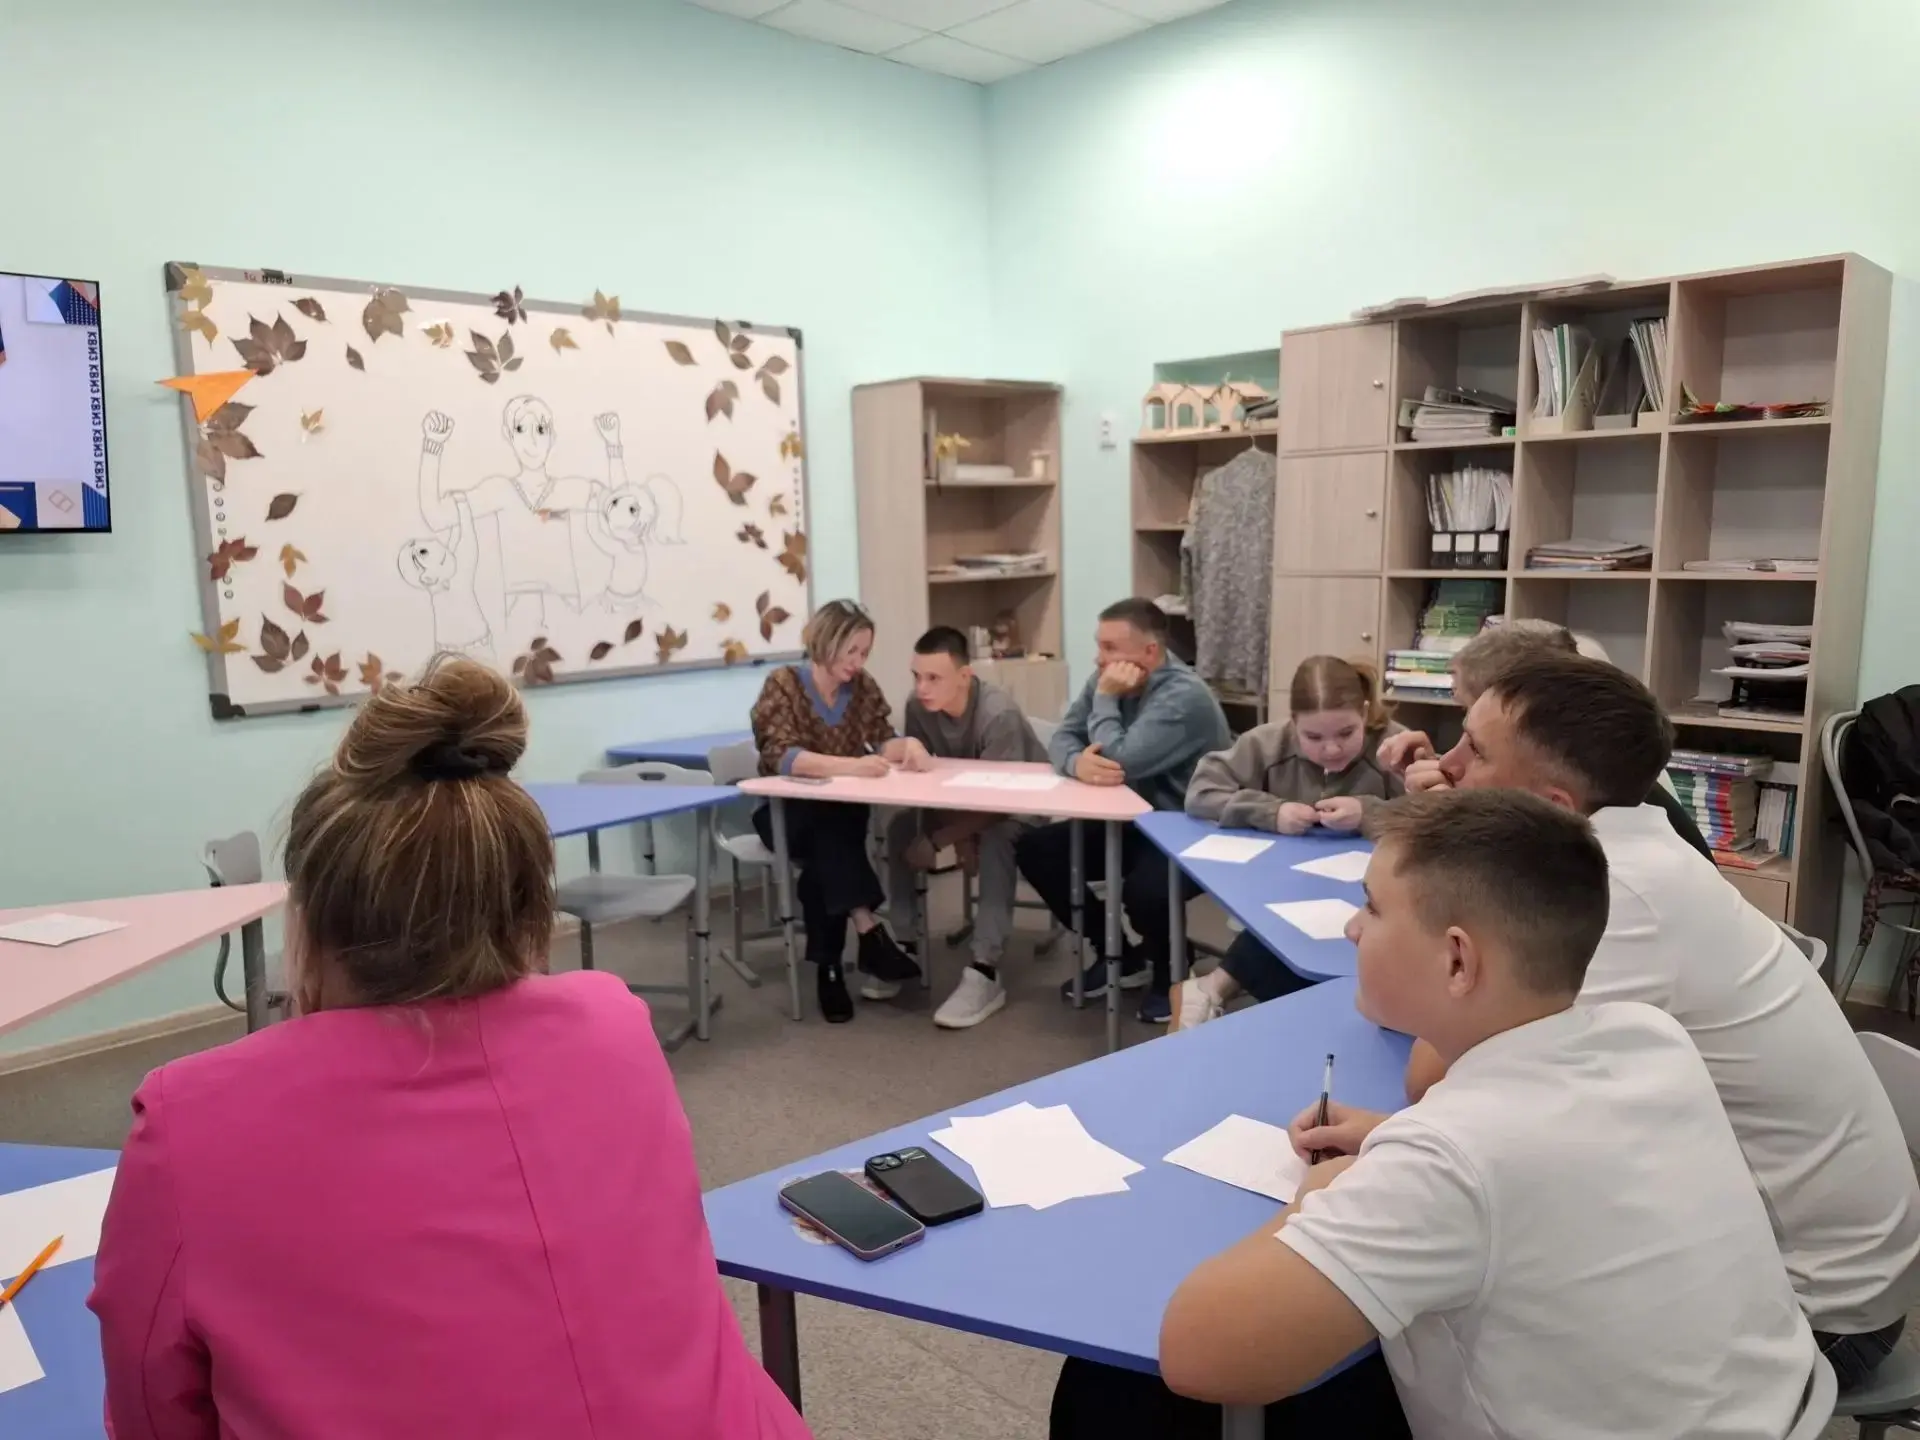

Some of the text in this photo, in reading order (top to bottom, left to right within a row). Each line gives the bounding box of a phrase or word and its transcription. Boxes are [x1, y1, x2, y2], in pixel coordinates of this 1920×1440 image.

[87, 331, 105, 490] КВИЗ КВИЗ КВИЗ КВИЗ КВИЗ
